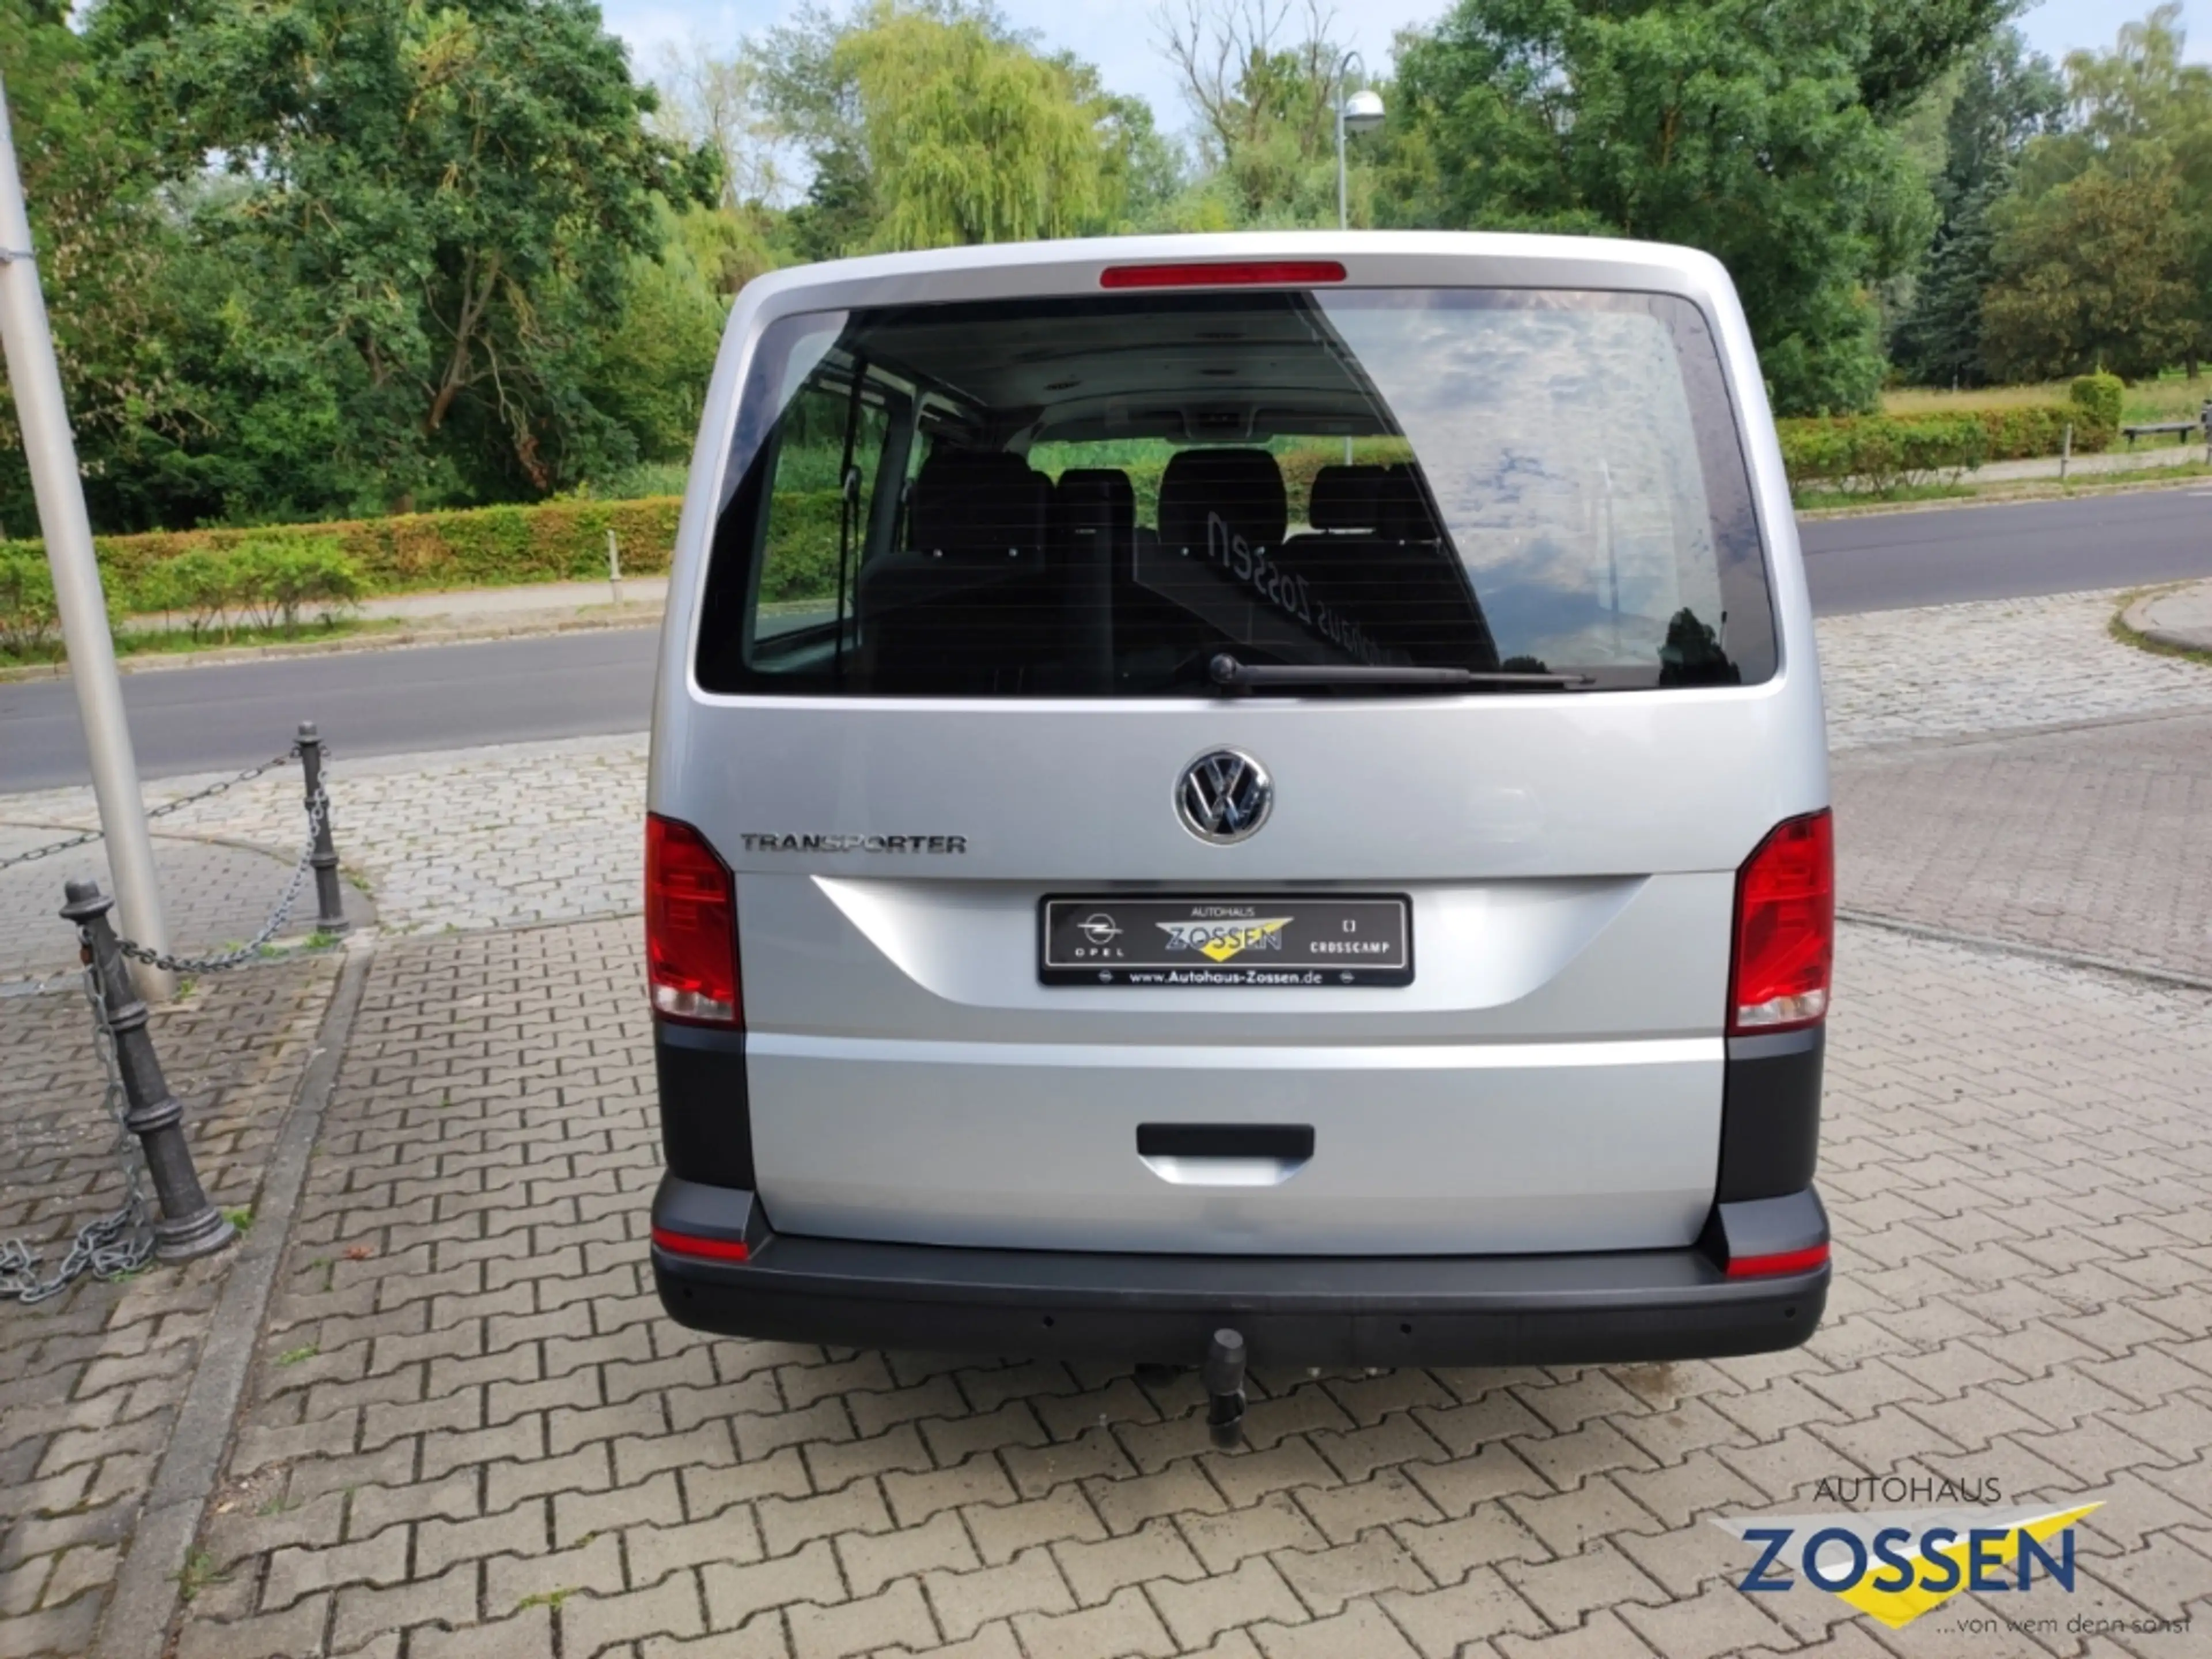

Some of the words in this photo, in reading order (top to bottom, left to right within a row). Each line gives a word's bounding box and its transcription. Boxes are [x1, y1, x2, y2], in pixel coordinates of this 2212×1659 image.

[741, 833, 968, 854] TRANSPORTER
[1191, 907, 1255, 917] AUTOHAUS
[1165, 926, 1281, 950] ZOSSEN
[1075, 948, 1124, 957] OPEL
[1310, 941, 1389, 953] CROSSCAMP
[1130, 970, 1323, 984] www.Autohaus-Zossen.de
